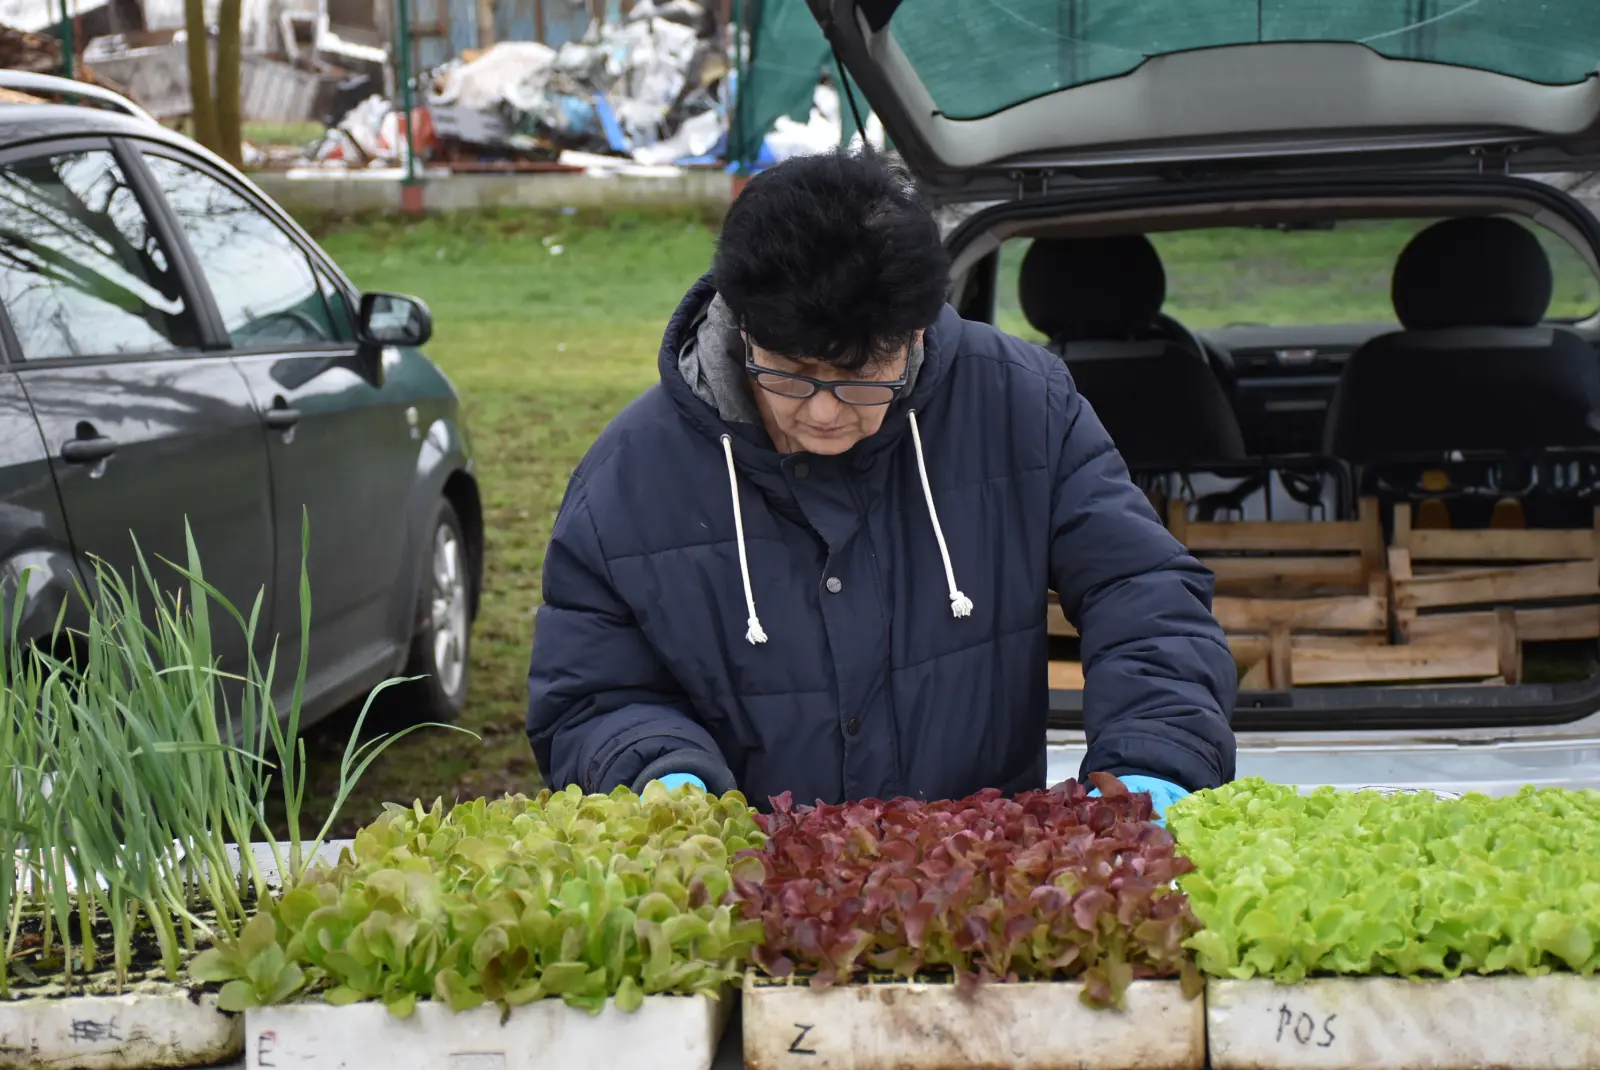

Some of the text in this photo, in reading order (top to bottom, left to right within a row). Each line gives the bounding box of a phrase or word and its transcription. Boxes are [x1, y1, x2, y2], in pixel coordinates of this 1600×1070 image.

[786, 1022, 817, 1056] Z
[1276, 1003, 1336, 1048] POS
[258, 1034, 277, 1068] E
